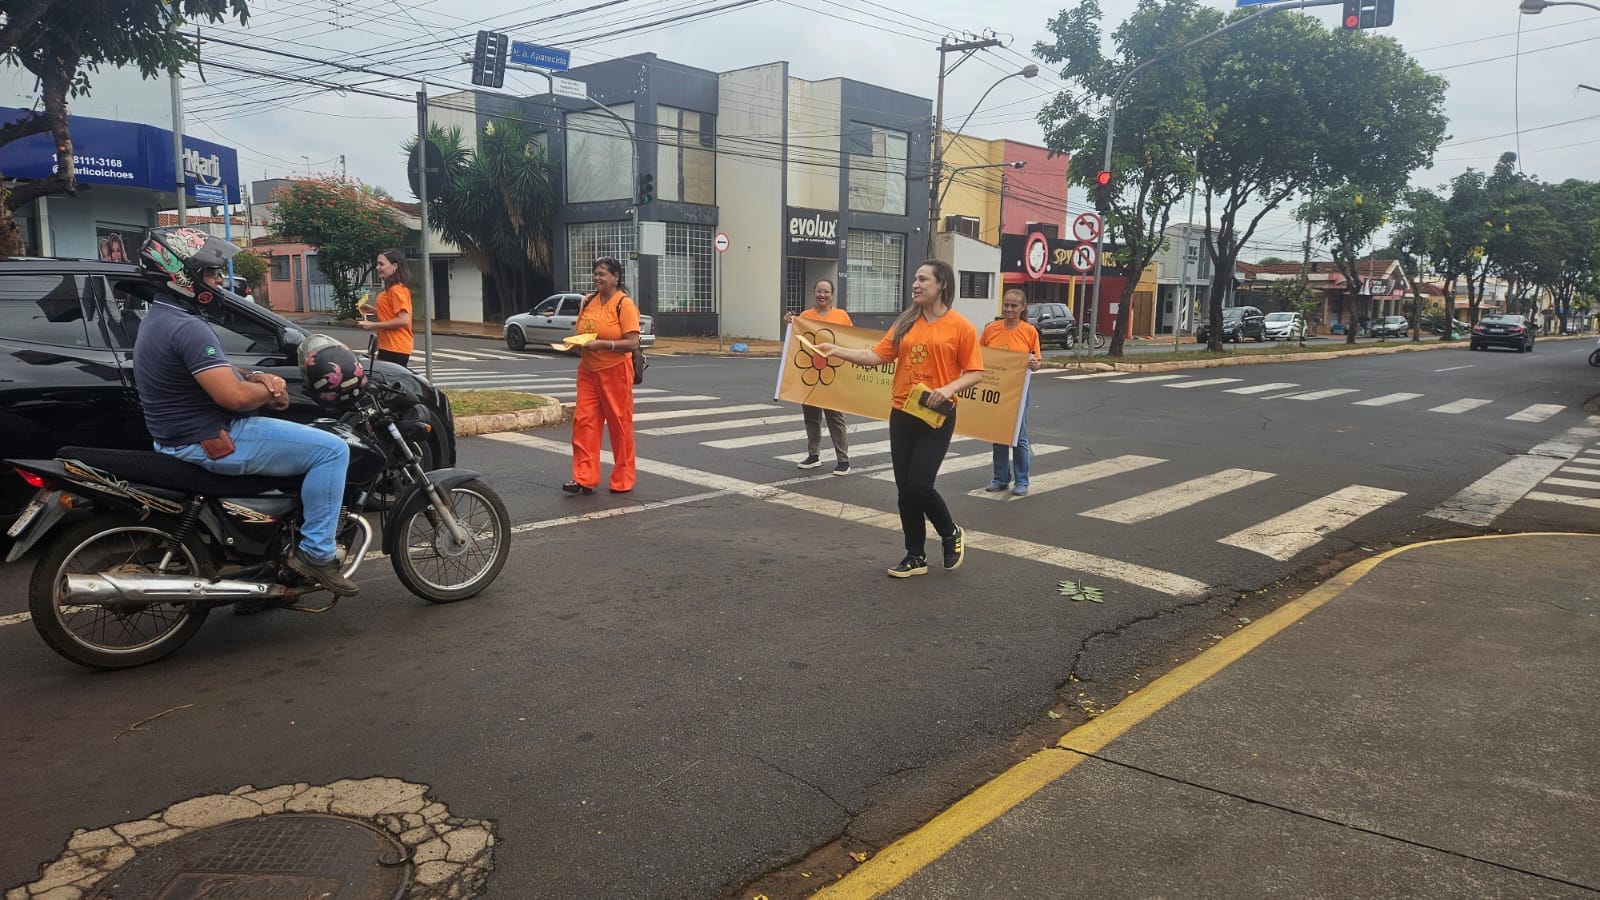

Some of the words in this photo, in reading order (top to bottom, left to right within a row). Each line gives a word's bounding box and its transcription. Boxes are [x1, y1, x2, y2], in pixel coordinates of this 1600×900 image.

[531, 51, 567, 65] Aparecida
[73, 155, 122, 168] 8111-3168
[52, 164, 134, 179] @arlicolchoes
[790, 214, 836, 238] evolux
[955, 387, 978, 401] QUE
[981, 388, 1001, 404] 100
